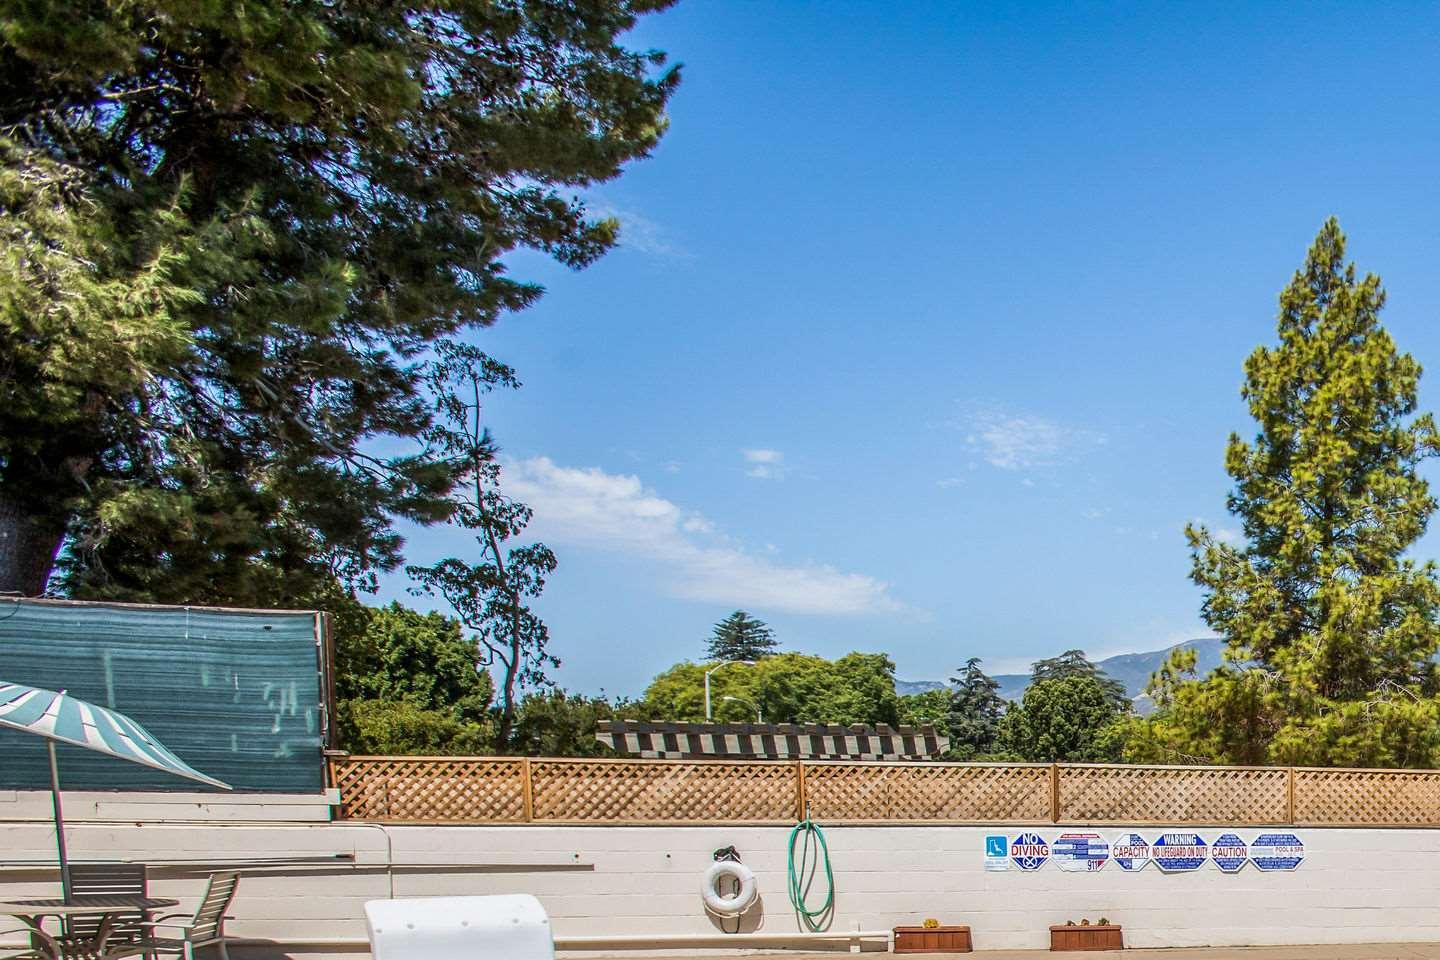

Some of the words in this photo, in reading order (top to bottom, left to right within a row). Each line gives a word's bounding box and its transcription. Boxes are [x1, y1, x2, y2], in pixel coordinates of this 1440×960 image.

[1022, 833, 1039, 845] NO
[1163, 833, 1198, 845] WARNING
[1011, 845, 1049, 856] DIVING
[1112, 846, 1150, 858] CAPACITY
[1152, 846, 1160, 857] NO
[1161, 846, 1187, 857] LIFEGUARD
[1187, 846, 1195, 857] ON
[1196, 846, 1208, 857] DUTY
[1211, 847, 1248, 857] CAUTION
[1087, 859, 1098, 870] 911
